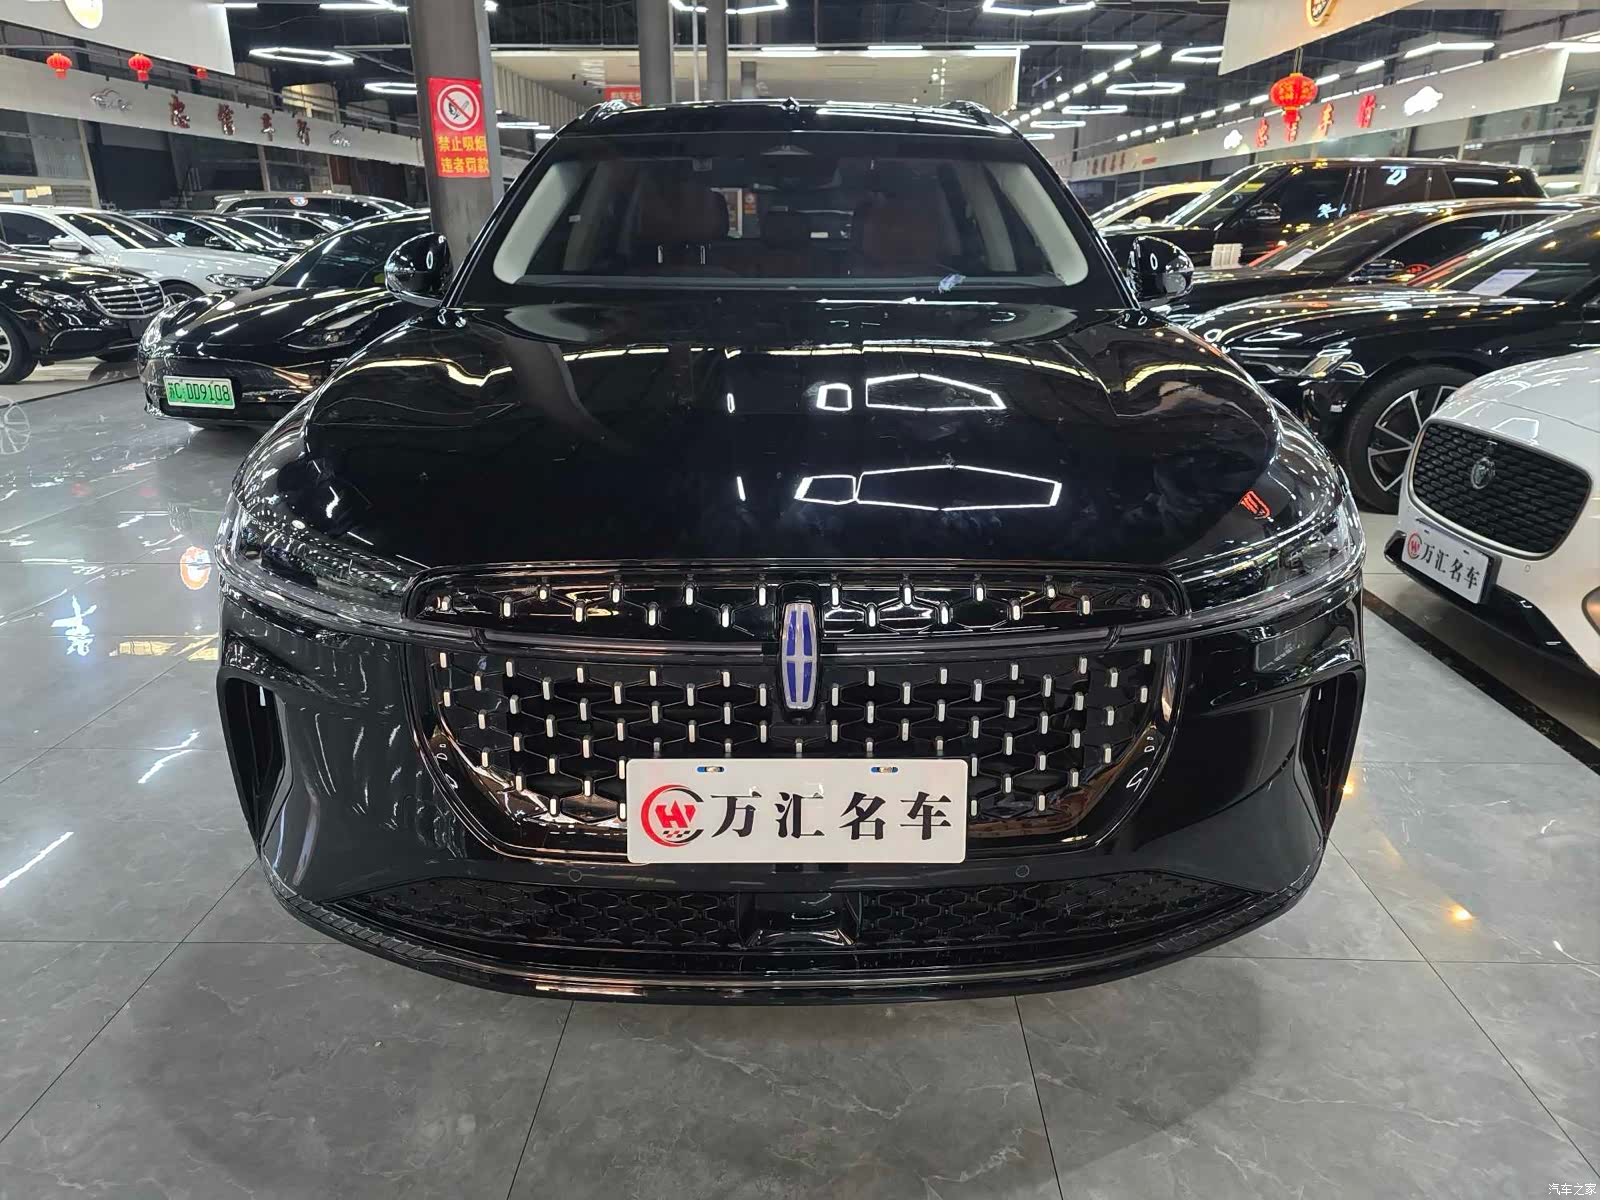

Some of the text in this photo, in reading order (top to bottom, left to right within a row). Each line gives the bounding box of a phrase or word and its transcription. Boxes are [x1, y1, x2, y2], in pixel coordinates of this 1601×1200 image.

[437, 135, 488, 152] 禁止吸烟
[441, 157, 490, 173] 违者罚款
[1421, 542, 1480, 589] 万汇名车
[710, 791, 952, 841] 万汇名车
